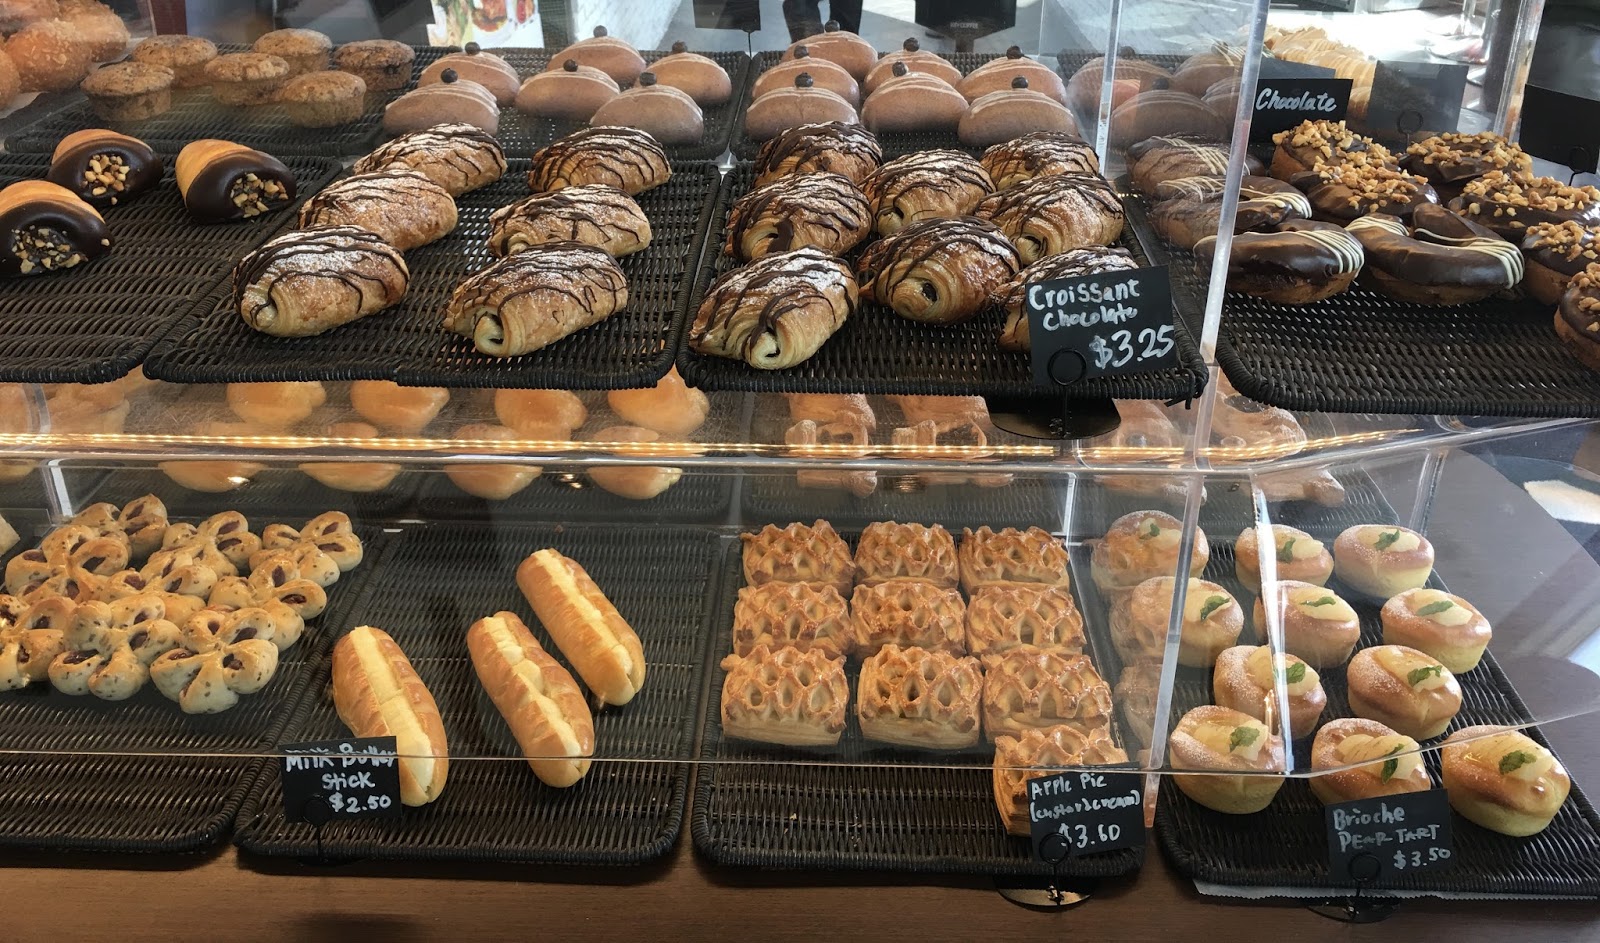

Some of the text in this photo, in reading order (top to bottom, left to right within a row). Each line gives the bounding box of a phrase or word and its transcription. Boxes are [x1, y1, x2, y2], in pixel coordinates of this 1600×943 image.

[1255, 87, 1337, 112] Chocolate
[1028, 278, 1140, 311] Croissant
[1042, 302, 1138, 331] Chocolate
[1088, 324, 1175, 370] $3.25
[328, 791, 392, 813] $2.50
[1332, 802, 1406, 831] Brioche
[1058, 823, 1121, 849] $3.60
[1392, 846, 1452, 870] $3.50
